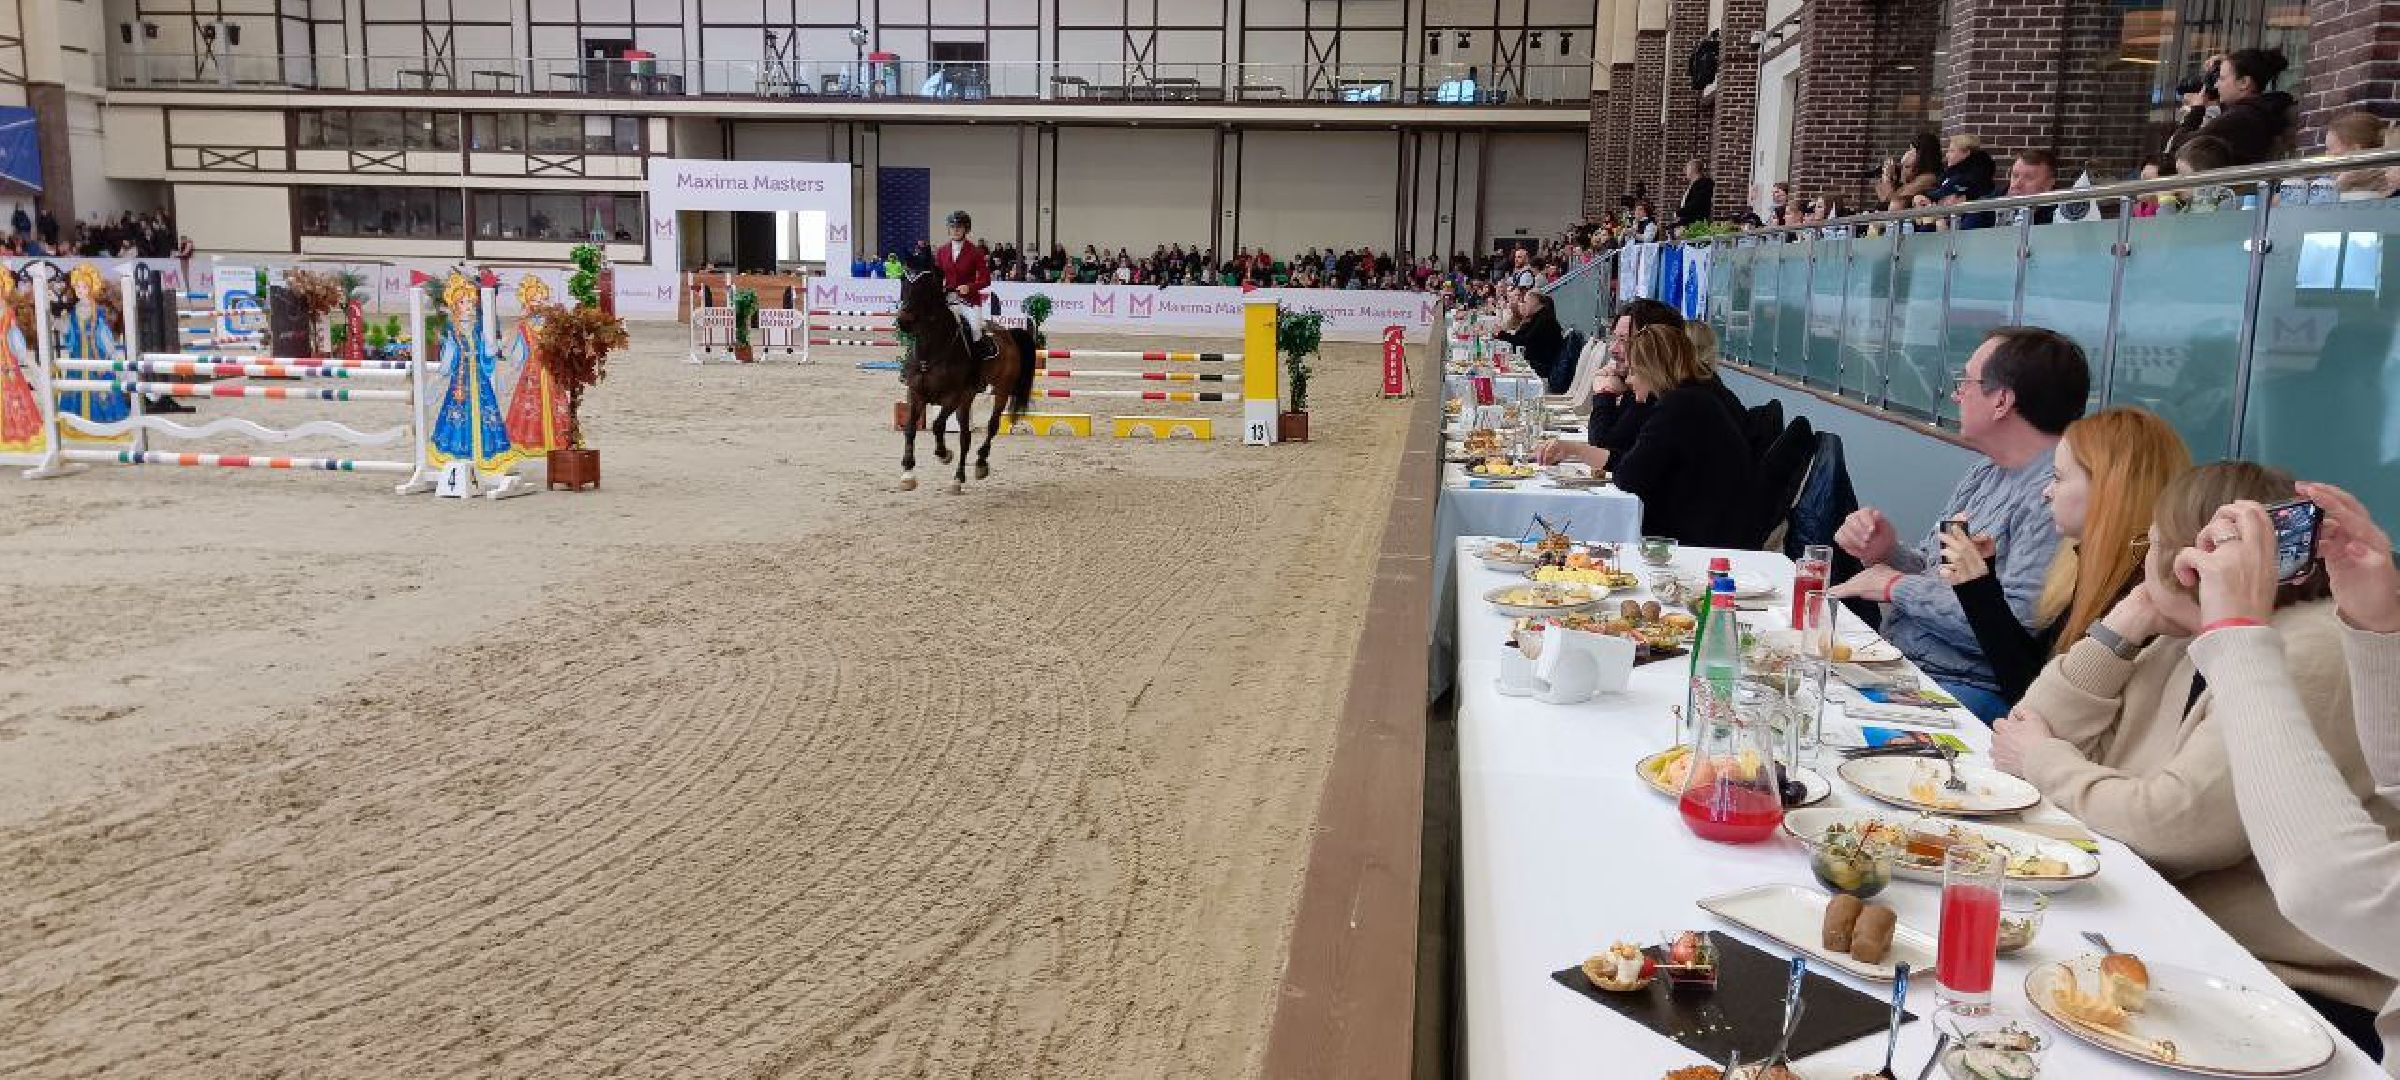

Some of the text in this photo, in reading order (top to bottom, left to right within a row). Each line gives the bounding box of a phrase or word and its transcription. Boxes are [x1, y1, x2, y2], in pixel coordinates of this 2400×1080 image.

[677, 173, 824, 192] Maxima Masters
[655, 217, 672, 236] M
[829, 224, 848, 241] M
[657, 285, 672, 300] M
[816, 285, 895, 305] M Maxima
[1092, 291, 1115, 313] M
[1130, 293, 1154, 315] M
[1158, 300, 1212, 314] Maxima
[1358, 306, 1412, 319] Masters
[1251, 424, 1264, 441] 13
[447, 467, 456, 491] 4
